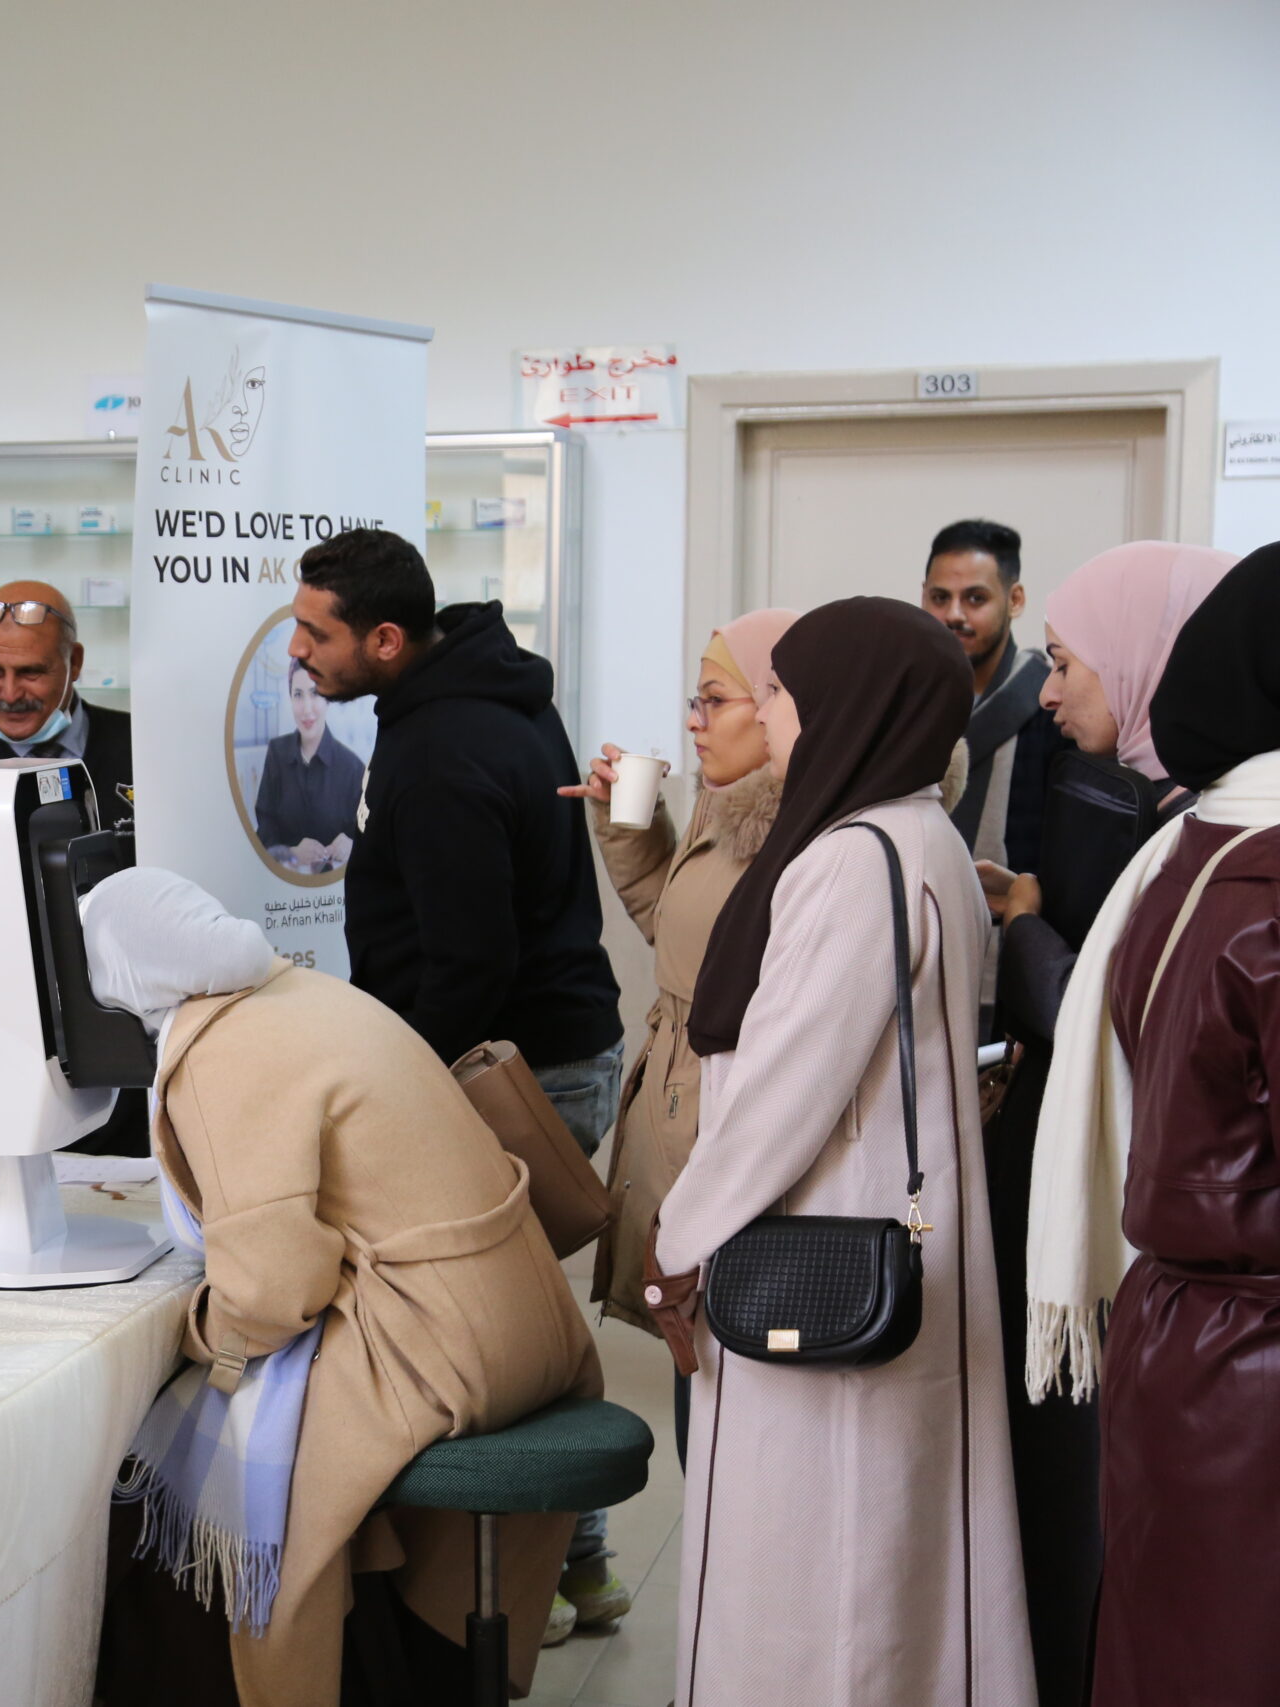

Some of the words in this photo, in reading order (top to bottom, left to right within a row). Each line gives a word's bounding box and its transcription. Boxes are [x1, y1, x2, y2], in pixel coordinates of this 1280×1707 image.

[608, 349, 677, 379] مخرج
[560, 384, 638, 402] EXIT
[926, 374, 971, 393] 303
[161, 466, 241, 486] CLINIC
[155, 509, 225, 538] WE'D
[235, 511, 294, 540] LOVE
[299, 514, 334, 541] TO
[153, 554, 212, 583] YOU
[223, 556, 250, 583] IN
[257, 557, 287, 584] AK
[266, 917, 280, 930] Dr.
[281, 913, 312, 928] Afnan
[314, 909, 343, 924] Khalil
